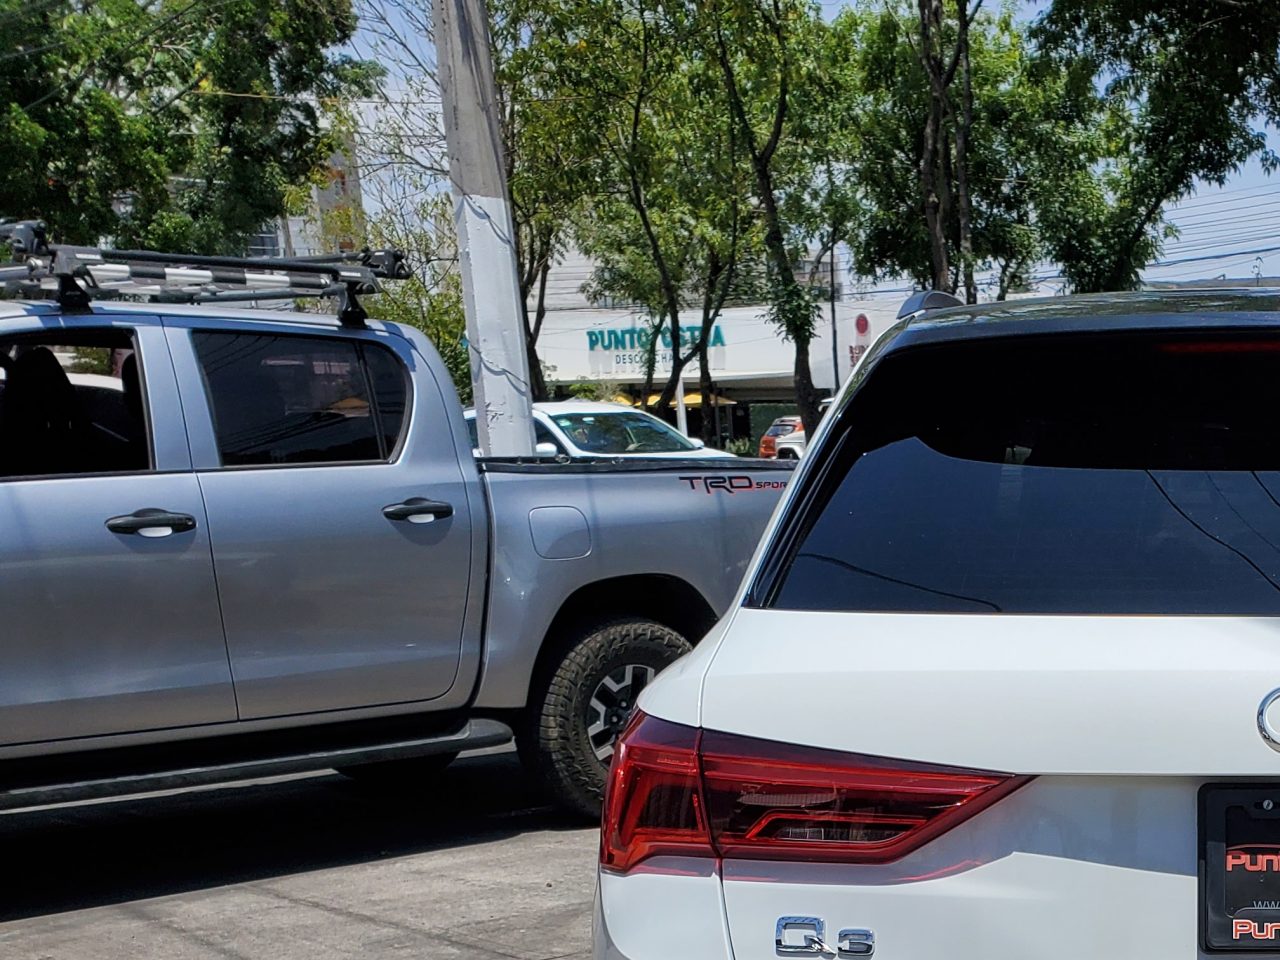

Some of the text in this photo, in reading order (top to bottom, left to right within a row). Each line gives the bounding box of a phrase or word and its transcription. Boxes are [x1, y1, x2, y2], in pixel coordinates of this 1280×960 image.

[587, 325, 726, 351] PUNTO OSTA
[678, 475, 754, 494] TRD
[776, 917, 874, 960] Q3
